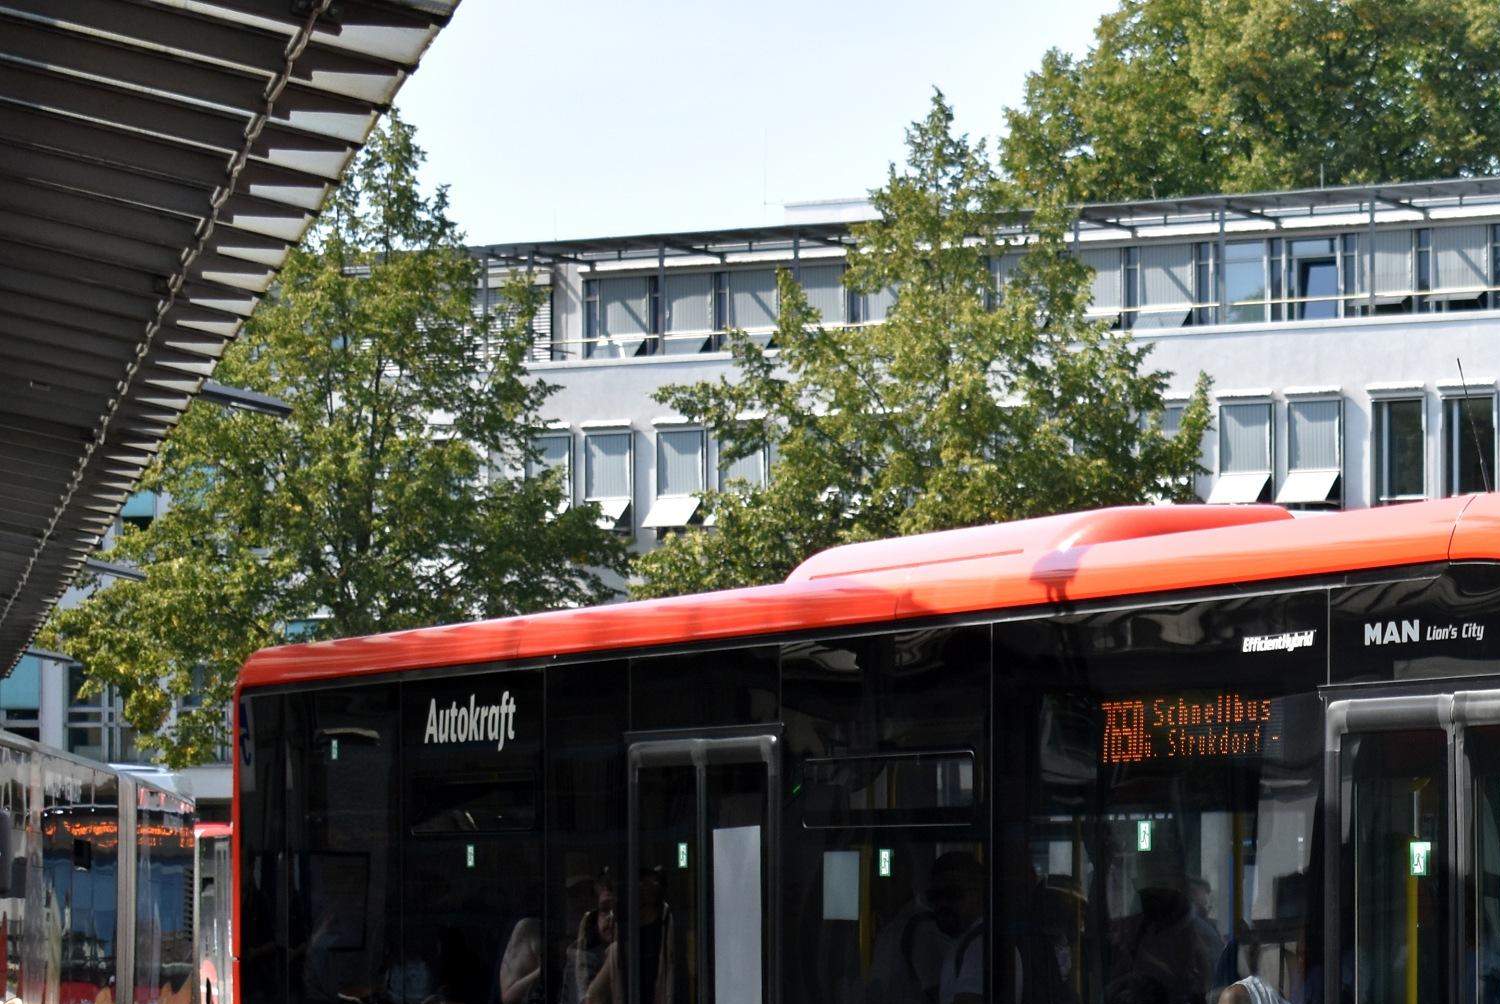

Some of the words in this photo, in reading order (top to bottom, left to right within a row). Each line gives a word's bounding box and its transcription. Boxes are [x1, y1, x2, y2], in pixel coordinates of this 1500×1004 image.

[1242, 631, 1314, 652] EfficientHybrid
[1364, 619, 1420, 646] MAN
[1426, 625, 1458, 641] Lion's
[1461, 622, 1485, 641] City
[424, 690, 516, 752] Autokraft
[1153, 694, 1271, 726] Schnellbus
[1102, 701, 1144, 762] 7650
